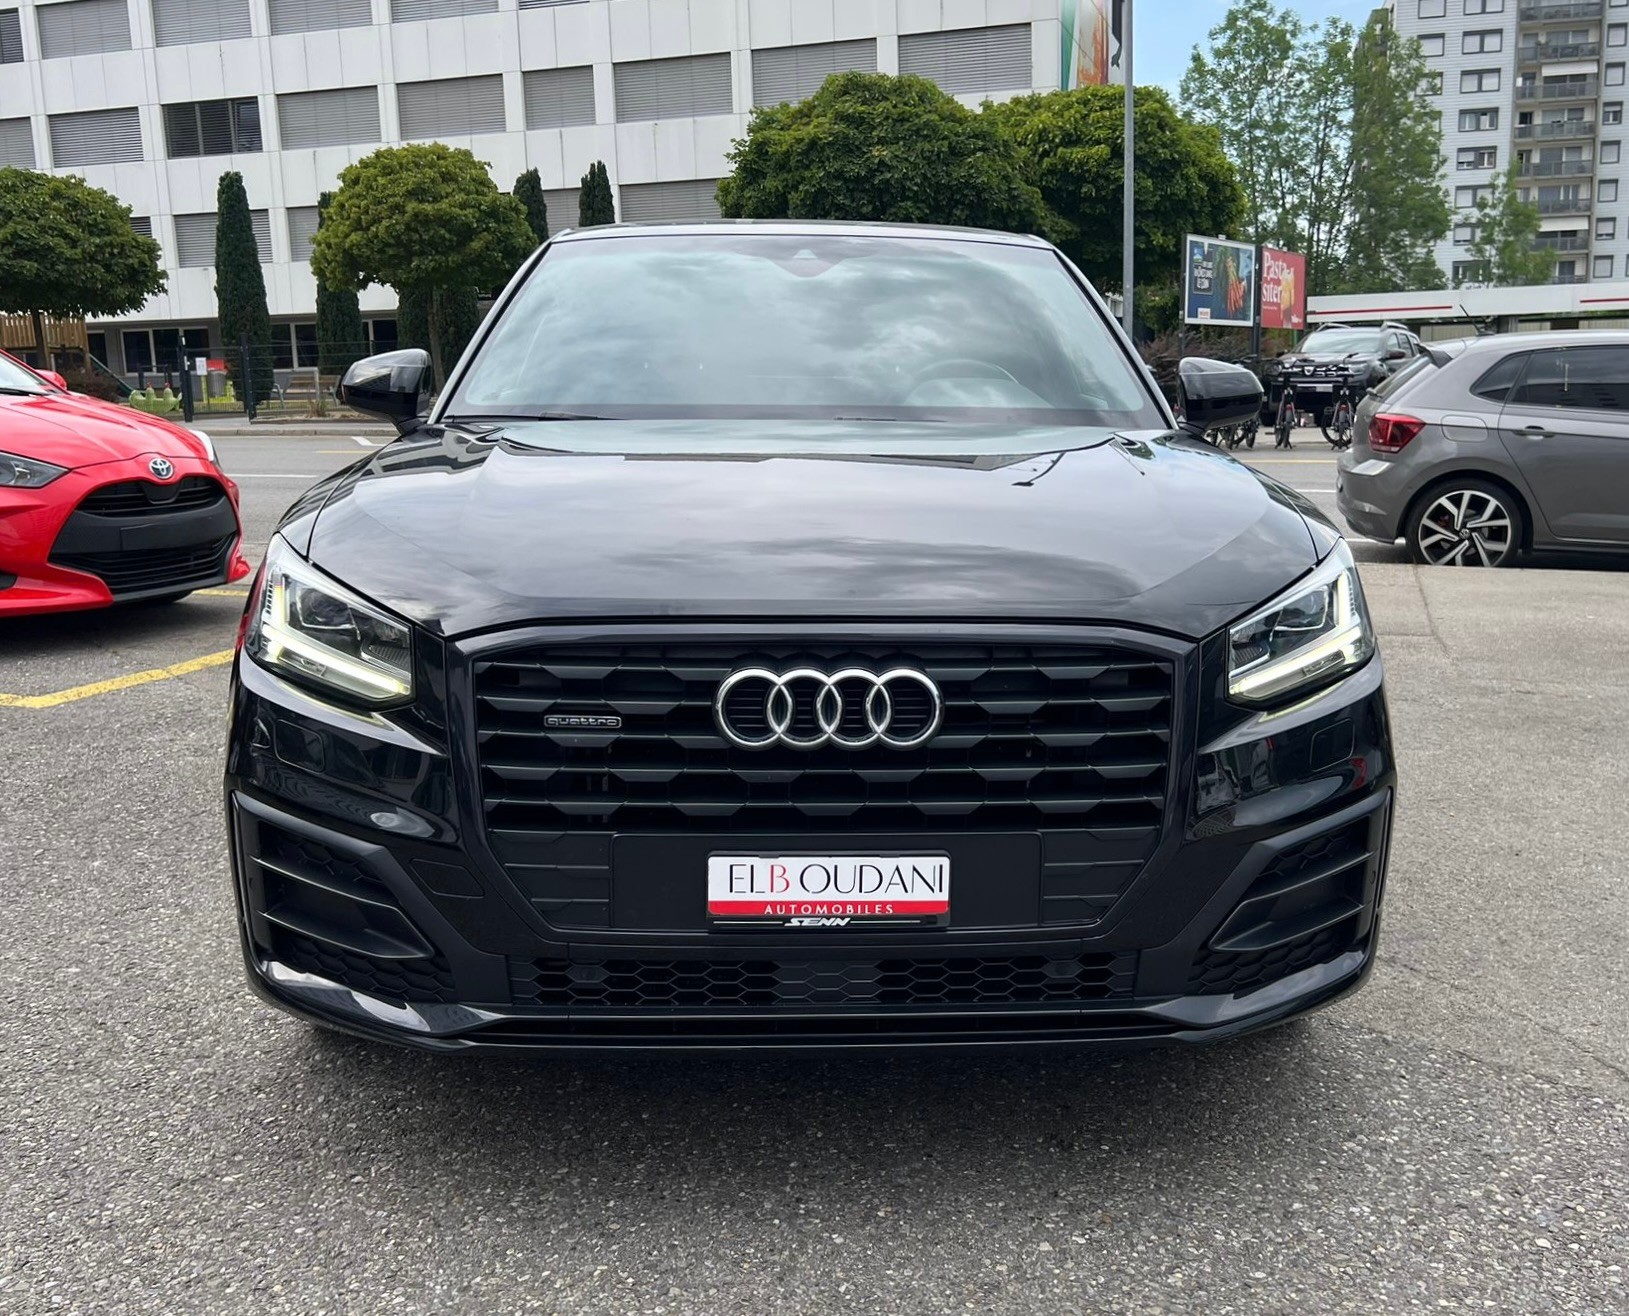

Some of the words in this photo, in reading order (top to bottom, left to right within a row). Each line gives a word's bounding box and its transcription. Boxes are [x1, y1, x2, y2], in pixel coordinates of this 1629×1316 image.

[547, 717, 618, 726] quattro
[764, 904, 894, 915] AUTOMOBILES
[784, 917, 851, 927] SENN
